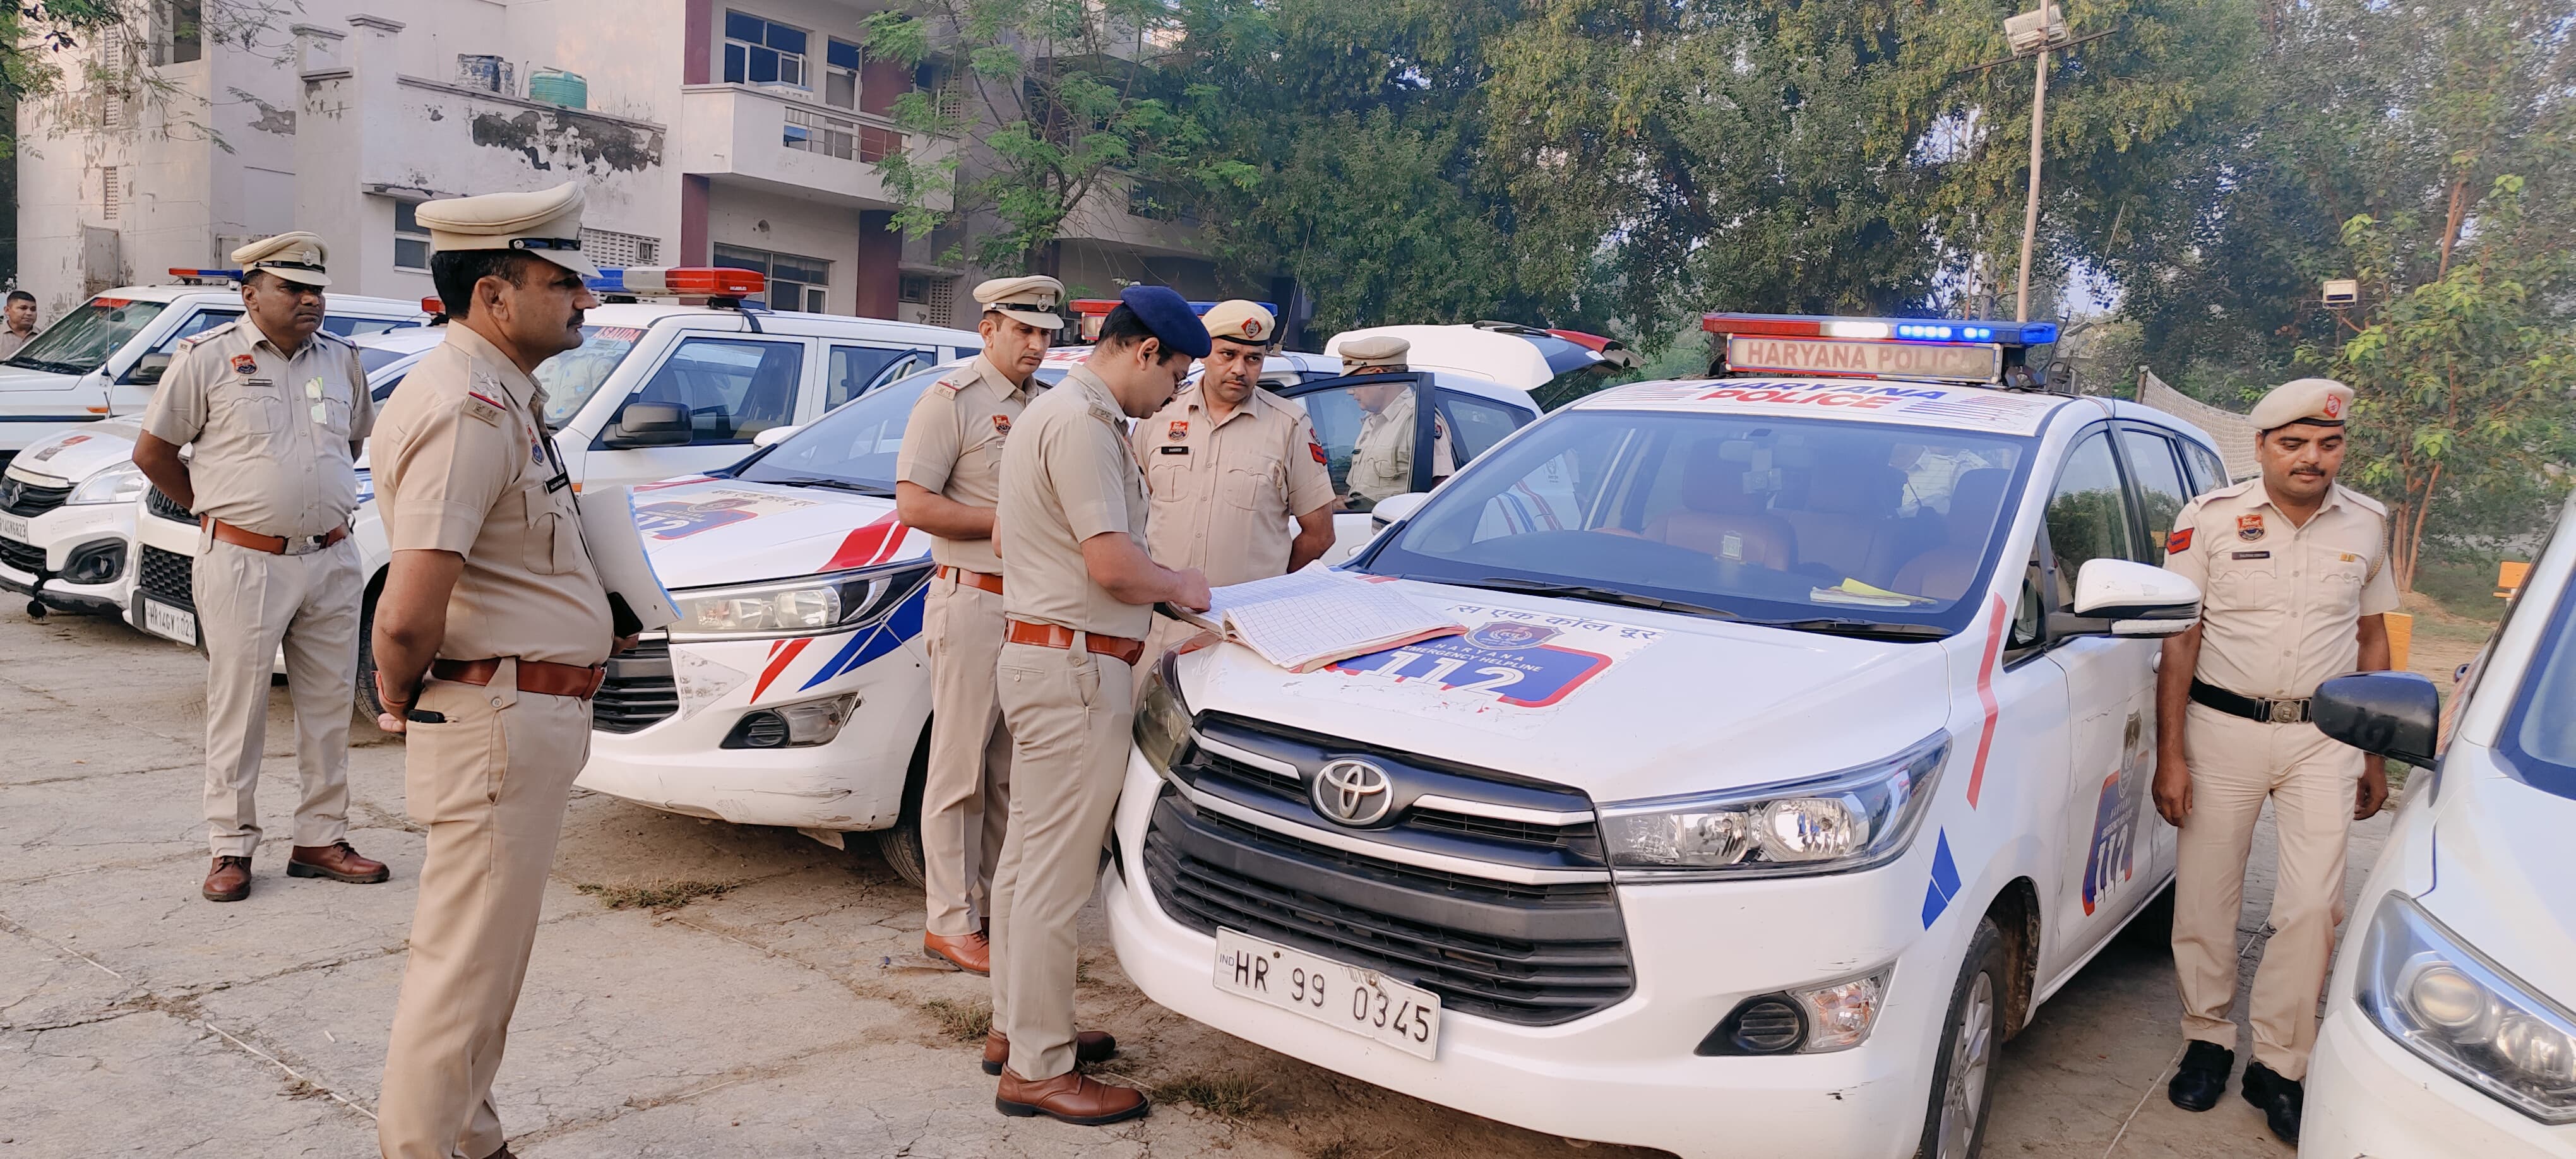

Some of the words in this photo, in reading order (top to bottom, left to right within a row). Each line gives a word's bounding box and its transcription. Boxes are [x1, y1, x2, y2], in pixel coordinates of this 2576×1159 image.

[1748, 342, 1867, 369] HARYANA
[1695, 382, 1948, 398] HARYANA
[1695, 389, 1903, 409] POLICE
[1445, 604, 1486, 614] स
[1491, 609, 1541, 619] एक
[1545, 616, 1616, 632] कॉल
[1402, 645, 1481, 662] EMERGENCY
[1480, 656, 1544, 673] HELPLINE
[1434, 643, 1525, 662] HARYANA
[1361, 650, 1526, 697] 112
[2094, 823, 2128, 904] 112
[1219, 953, 1234, 967] IND
[1235, 949, 1269, 993] HR
[1292, 968, 1325, 1007] 99
[1354, 986, 1431, 1042] 0345
